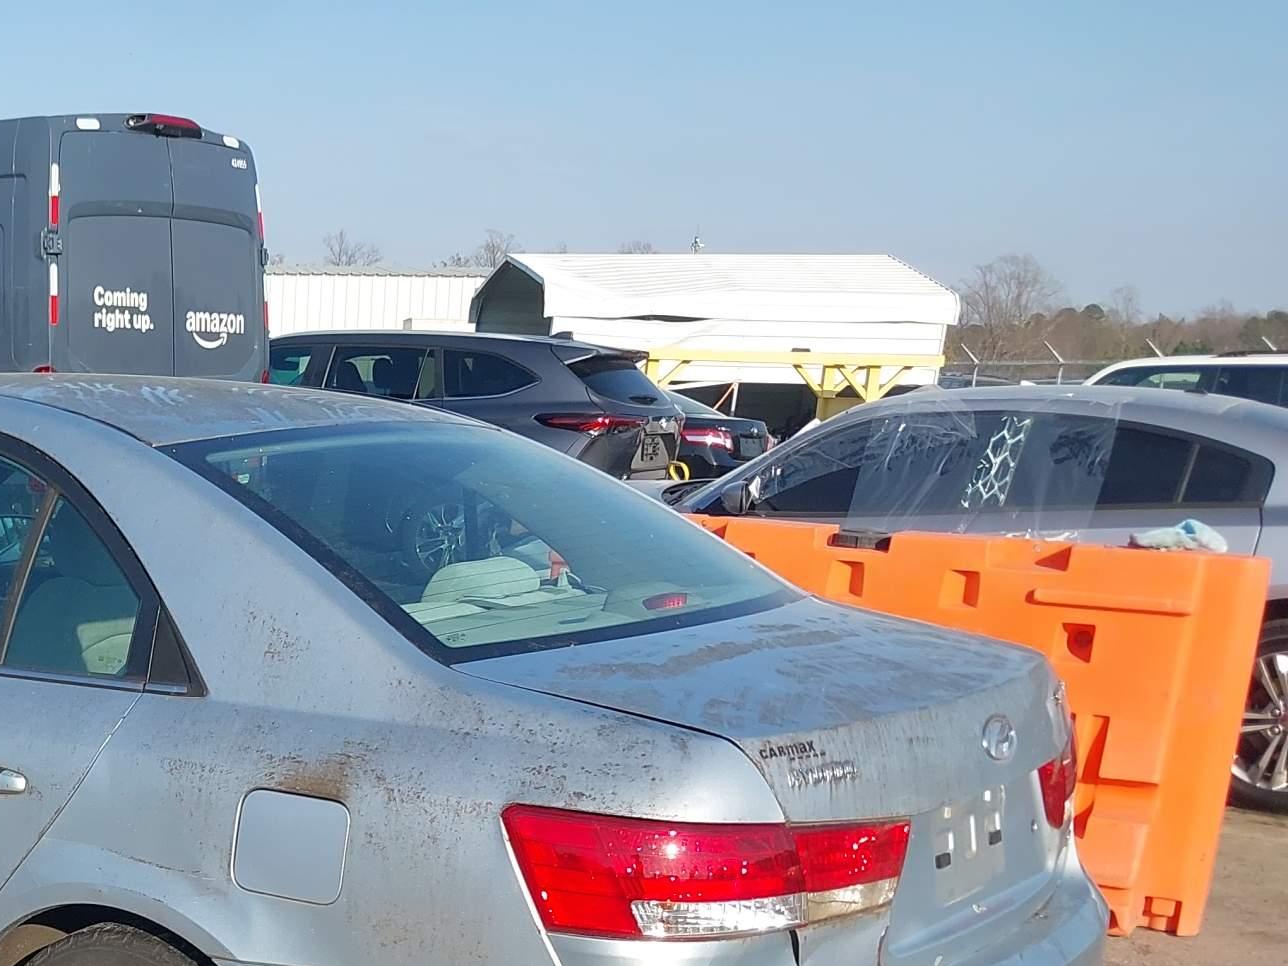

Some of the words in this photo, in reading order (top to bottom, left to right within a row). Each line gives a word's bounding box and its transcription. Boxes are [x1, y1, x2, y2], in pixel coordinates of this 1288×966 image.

[93, 285, 148, 312] Coming
[93, 308, 132, 332] right
[132, 314, 154, 333] up.
[185, 310, 245, 335] amazon
